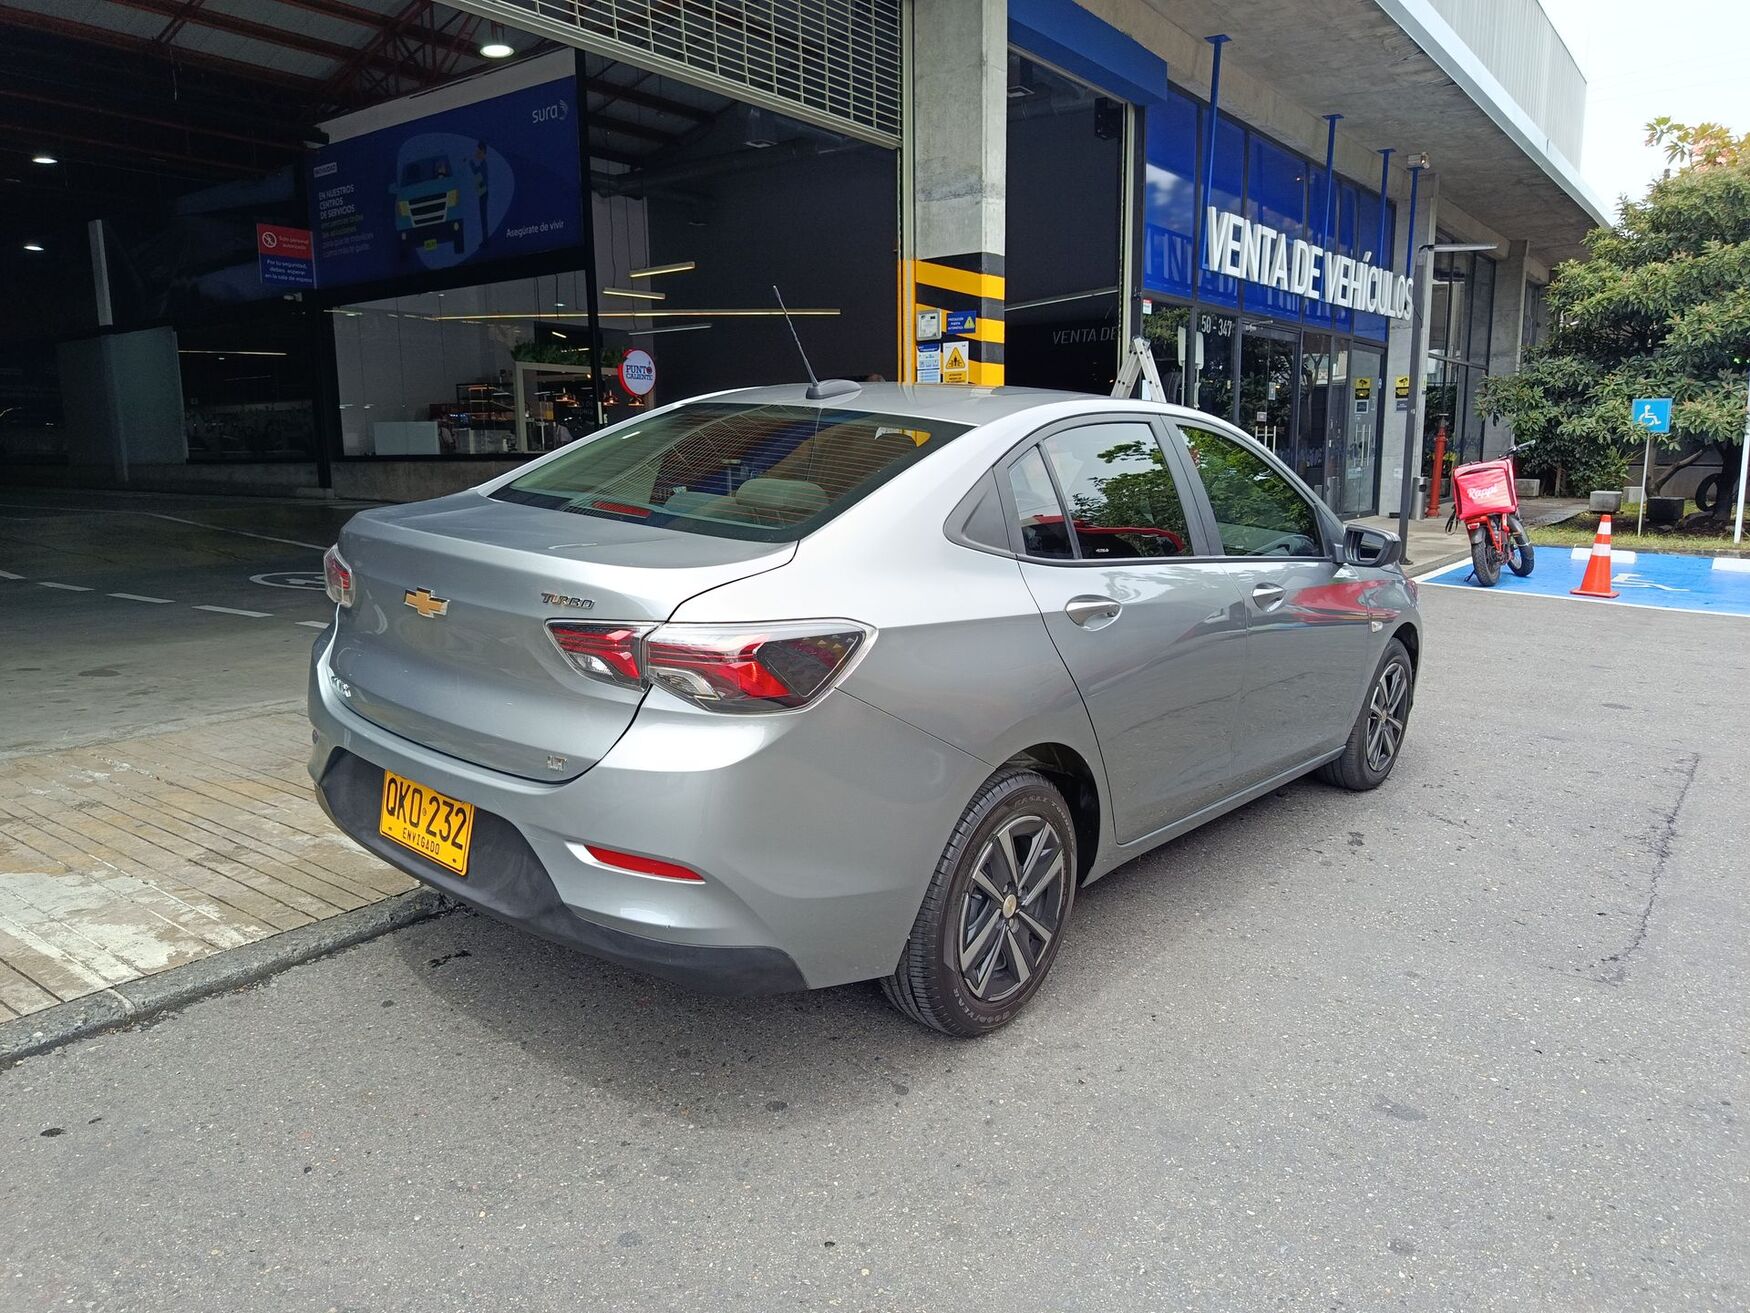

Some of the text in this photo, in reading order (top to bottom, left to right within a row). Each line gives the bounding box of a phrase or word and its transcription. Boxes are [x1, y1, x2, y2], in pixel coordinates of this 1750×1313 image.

[532, 103, 558, 124] sura
[540, 222, 549, 232] de
[1207, 206, 1414, 321] VENTA DE VEHÍCULOS
[1201, 315, 1211, 333] 50
[1218, 318, 1232, 337] 347
[1053, 328, 1097, 344] VENTA
[626, 364, 653, 374] PUNTO
[626, 373, 653, 381] CALIENTE
[541, 592, 595, 609] TURBO
[425, 795, 467, 851] 232
[403, 827, 441, 855] ENVIGADO
